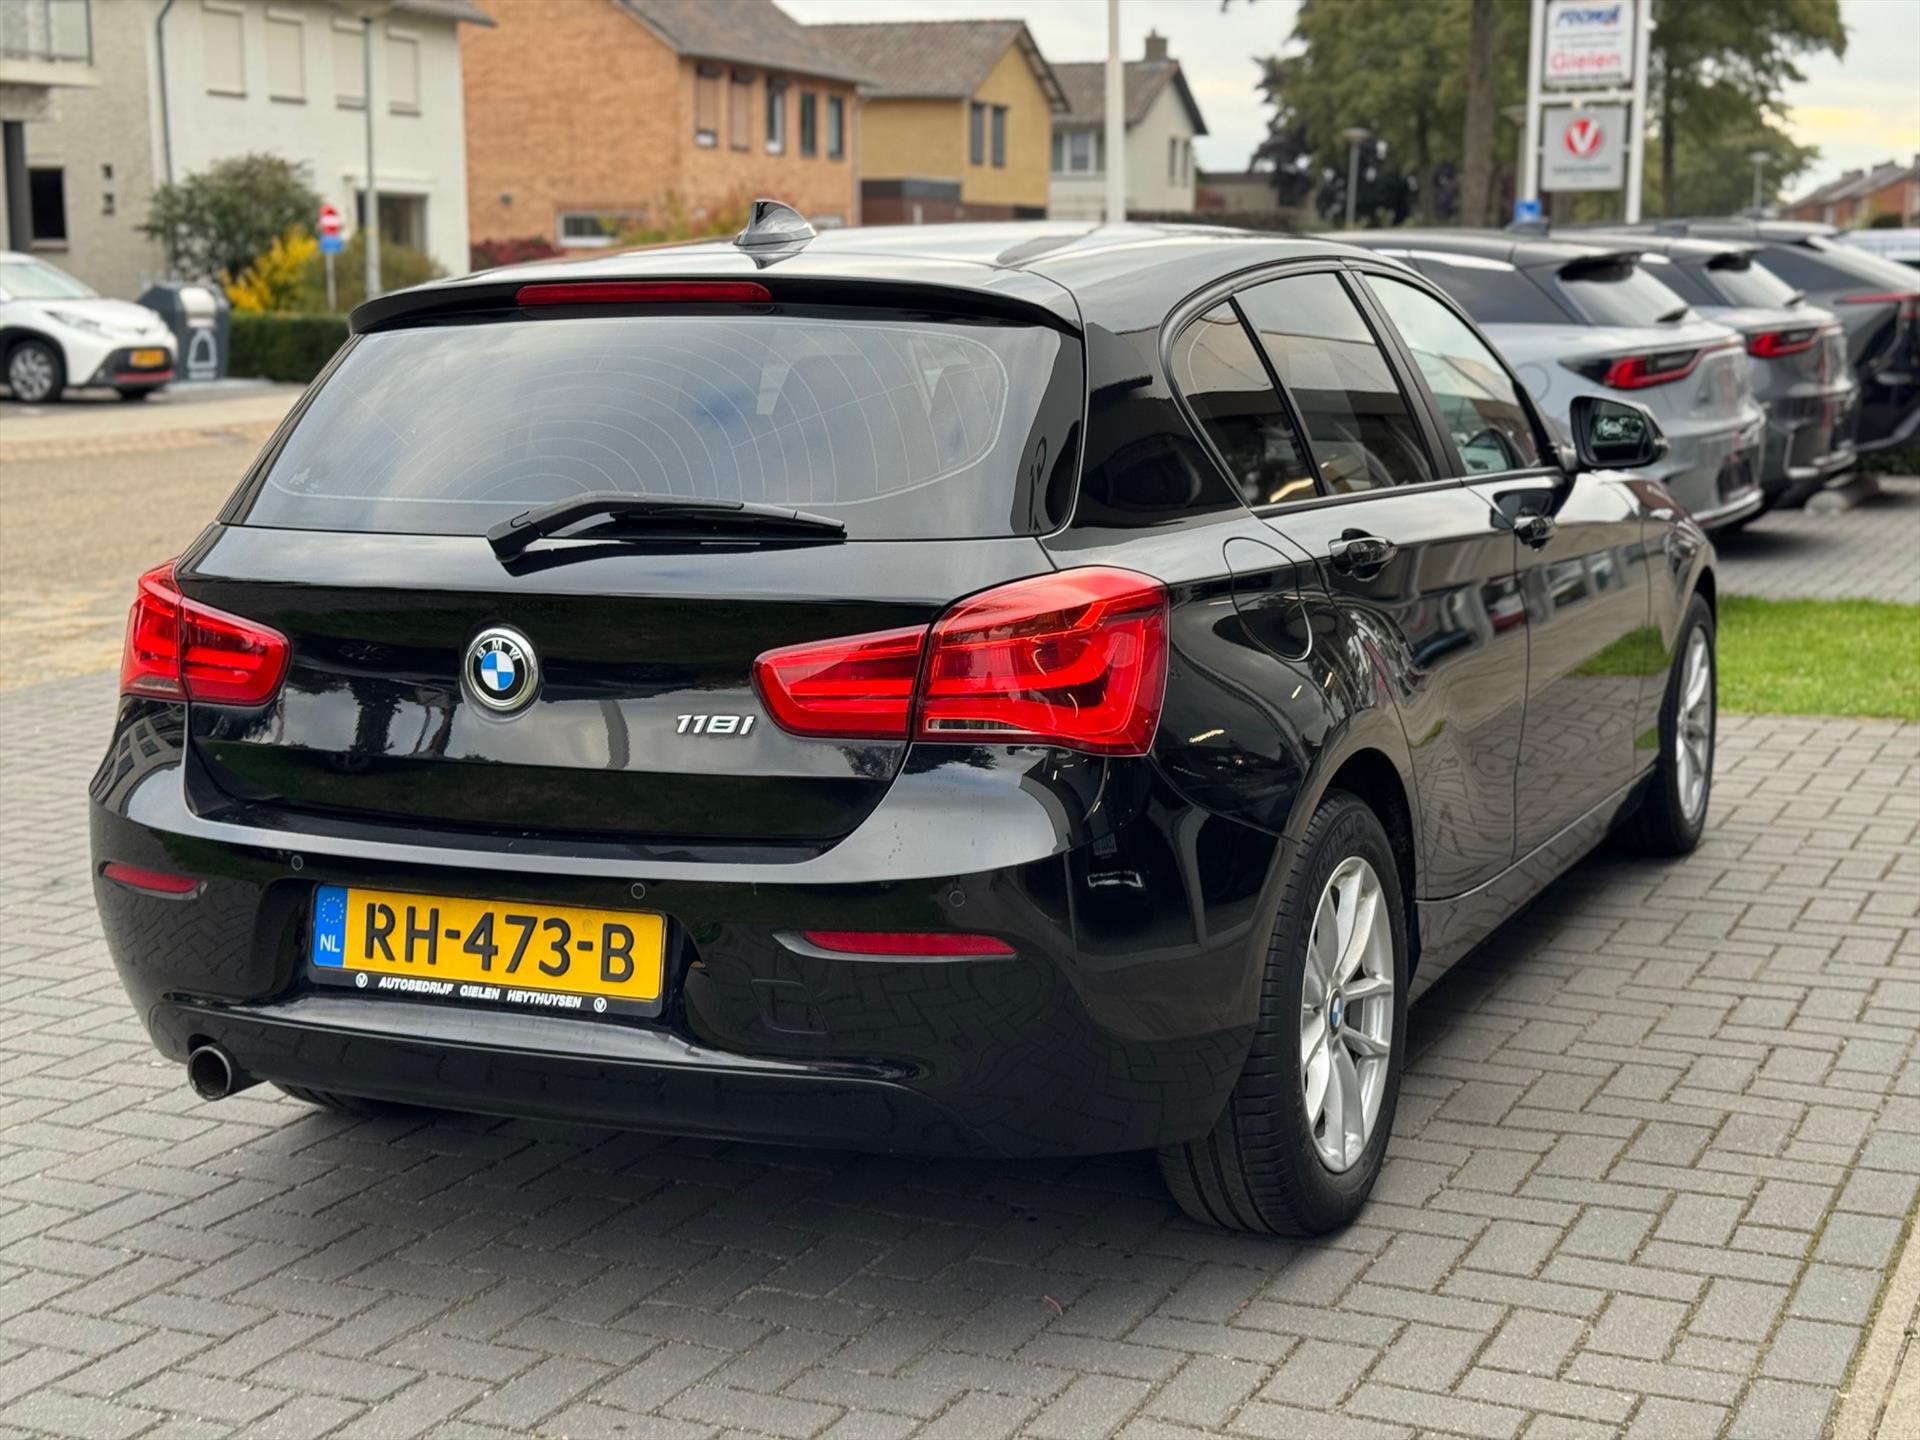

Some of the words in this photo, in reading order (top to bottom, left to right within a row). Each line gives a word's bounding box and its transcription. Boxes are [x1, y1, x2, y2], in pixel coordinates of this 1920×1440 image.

[476, 639, 521, 661] BMW
[320, 933, 341, 953] NL
[364, 902, 635, 983] RH-473-B
[378, 976, 454, 995] AUTOBEDRIJF
[459, 984, 501, 1000] GIELEN
[506, 989, 583, 1009] HEYTHUYSEN
